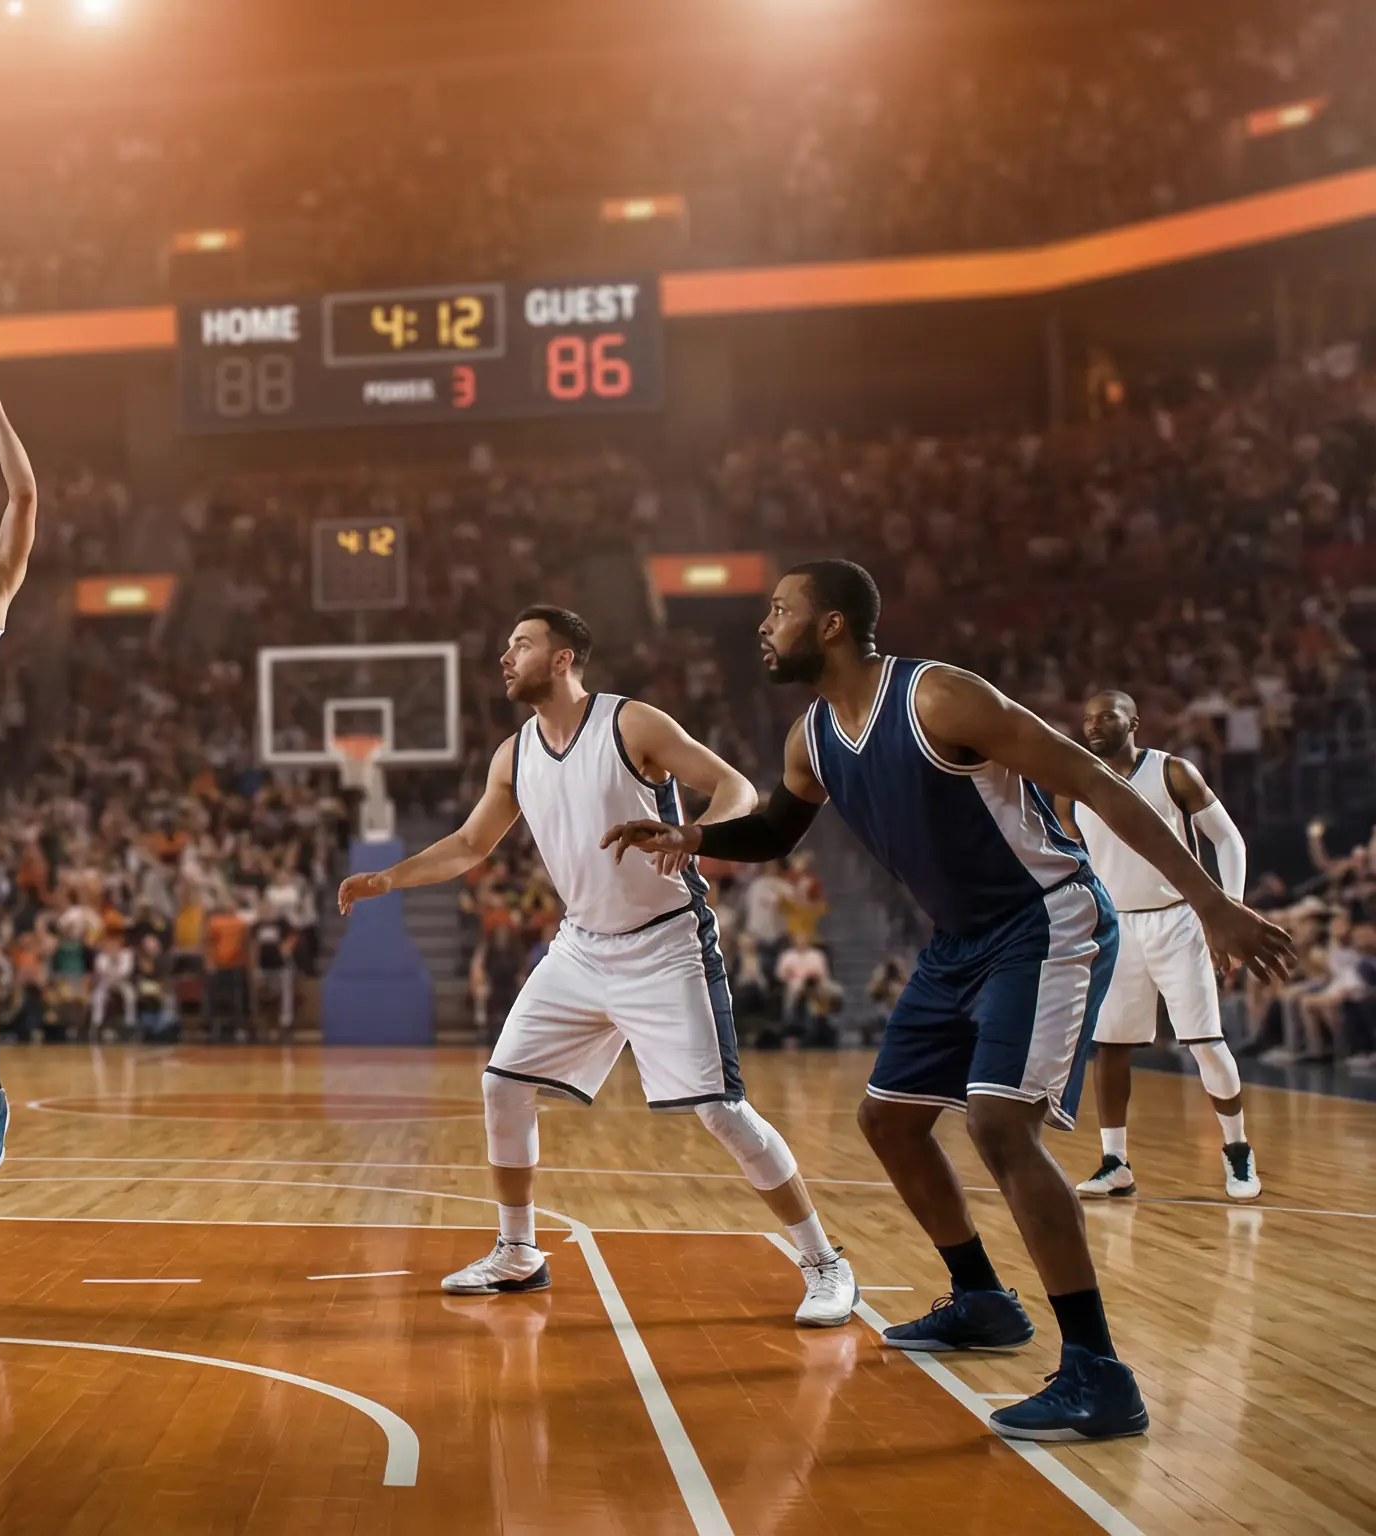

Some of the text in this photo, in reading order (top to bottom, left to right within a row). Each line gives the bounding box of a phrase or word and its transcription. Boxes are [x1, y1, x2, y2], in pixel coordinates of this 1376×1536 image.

[201, 305, 301, 345] HOME
[525, 285, 639, 326] GUEST
[451, 365, 476, 408] 3
[546, 333, 631, 400] 86
